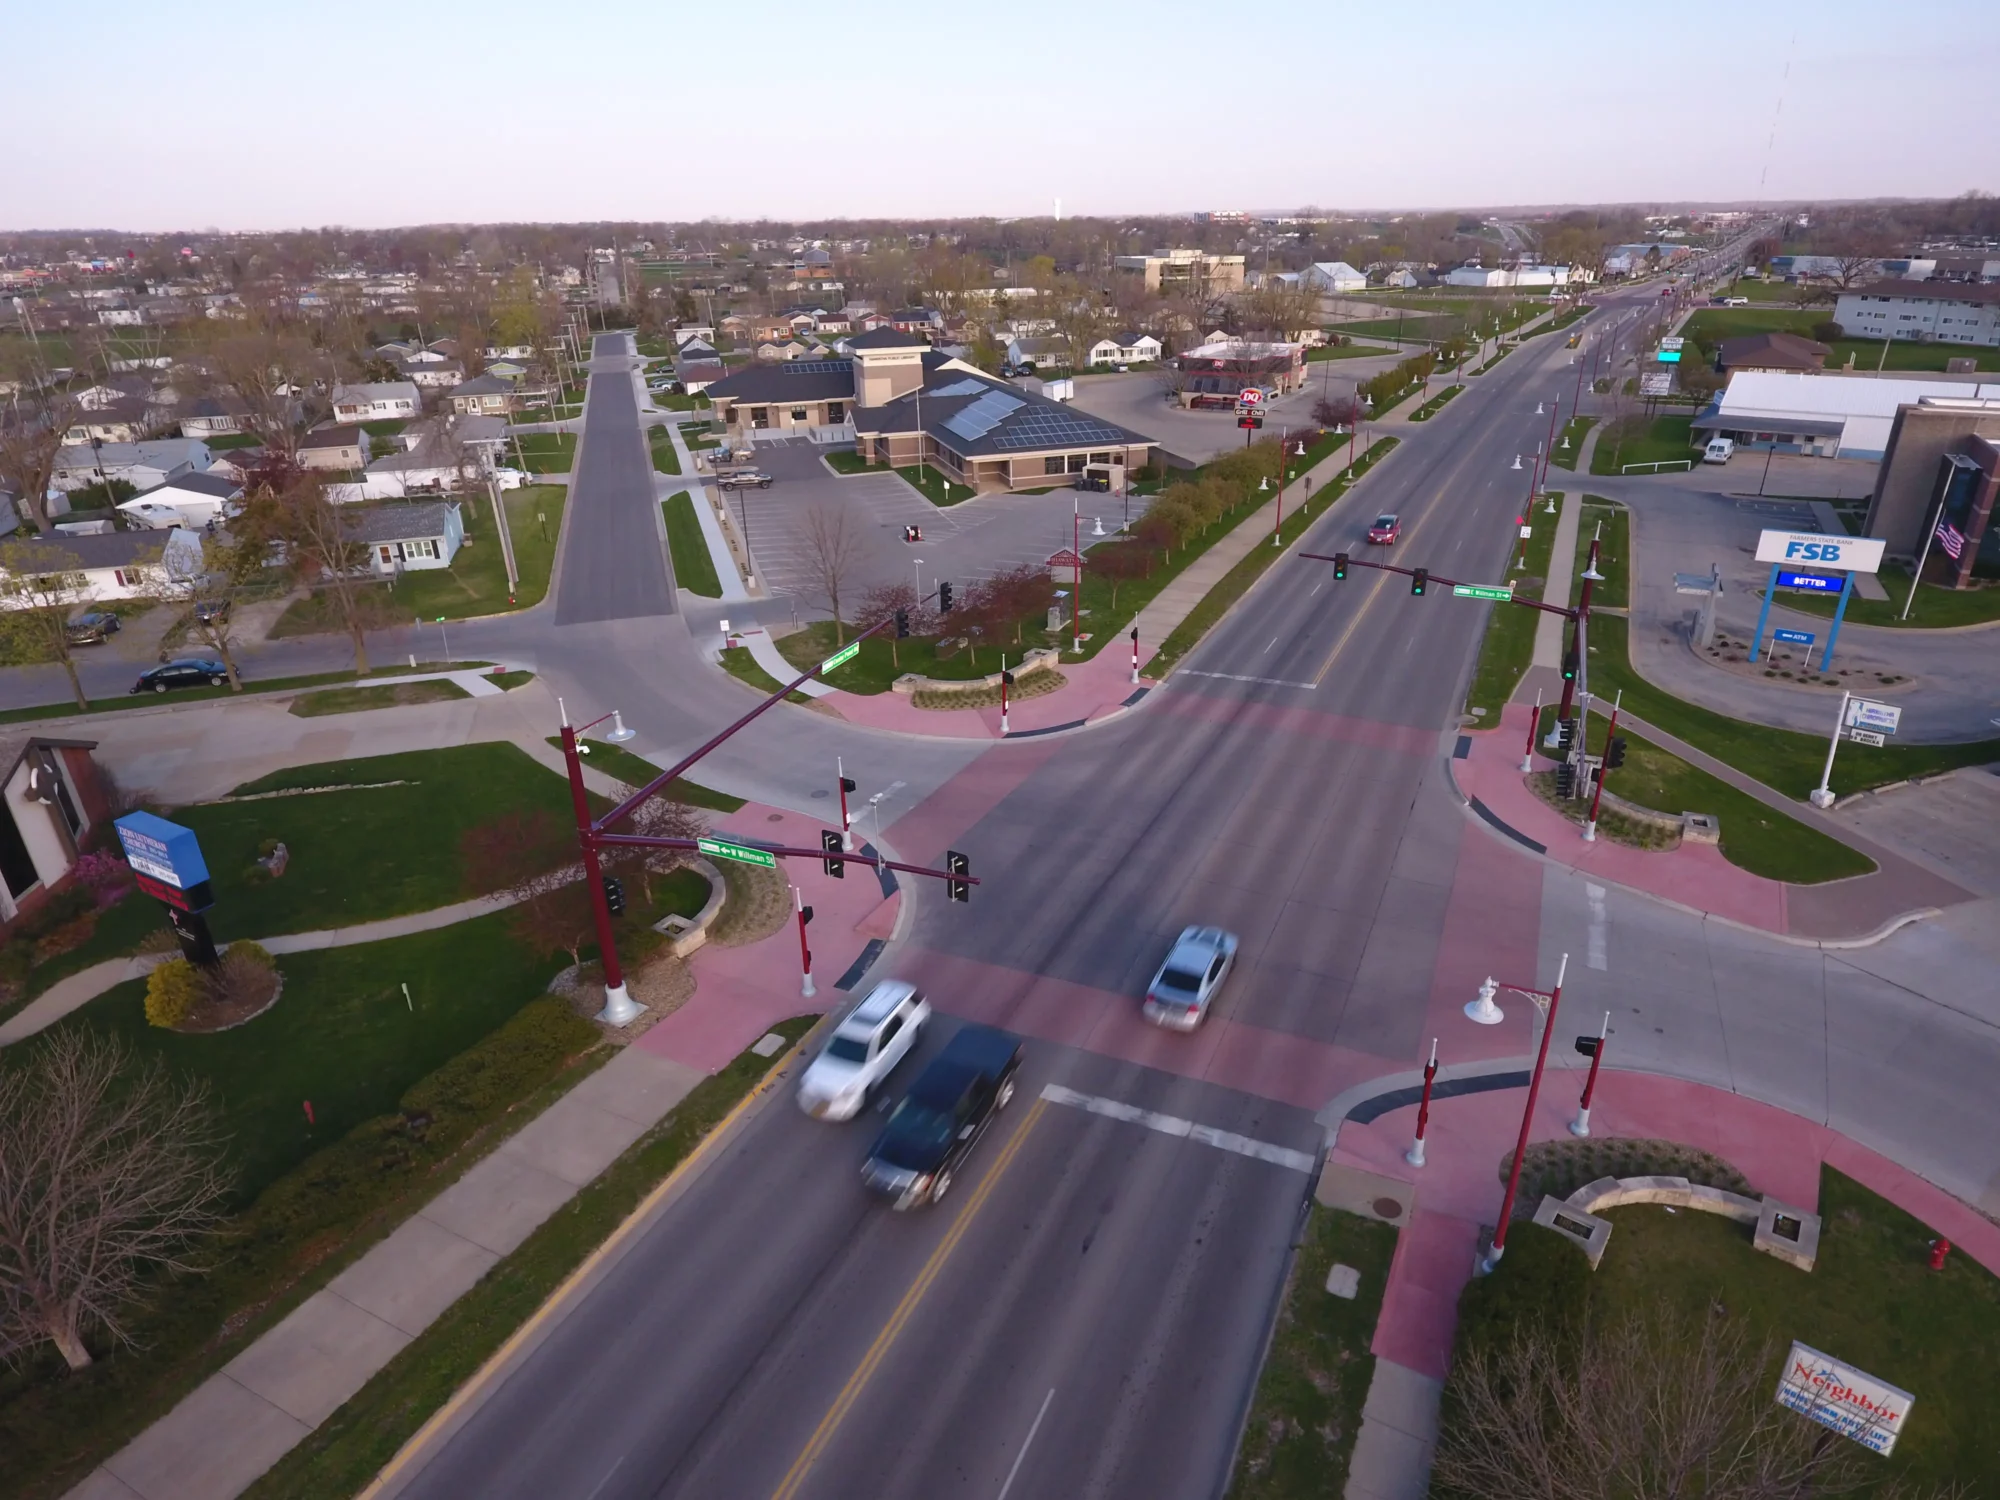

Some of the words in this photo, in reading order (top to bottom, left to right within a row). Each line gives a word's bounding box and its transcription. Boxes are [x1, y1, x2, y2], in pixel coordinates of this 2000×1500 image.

[1243, 392, 1259, 402] DQ
[1789, 535, 1817, 543] FARMERS
[1785, 542, 1840, 561] FSB
[1793, 577, 1826, 587] BETTER
[124, 837, 146, 849] CHURCH
[135, 832, 167, 851] LUTHERAN
[730, 848, 737, 856] W
[737, 849, 765, 863] Willman
[765, 855, 774, 865] St
[1793, 1361, 1900, 1421] Neighbor
